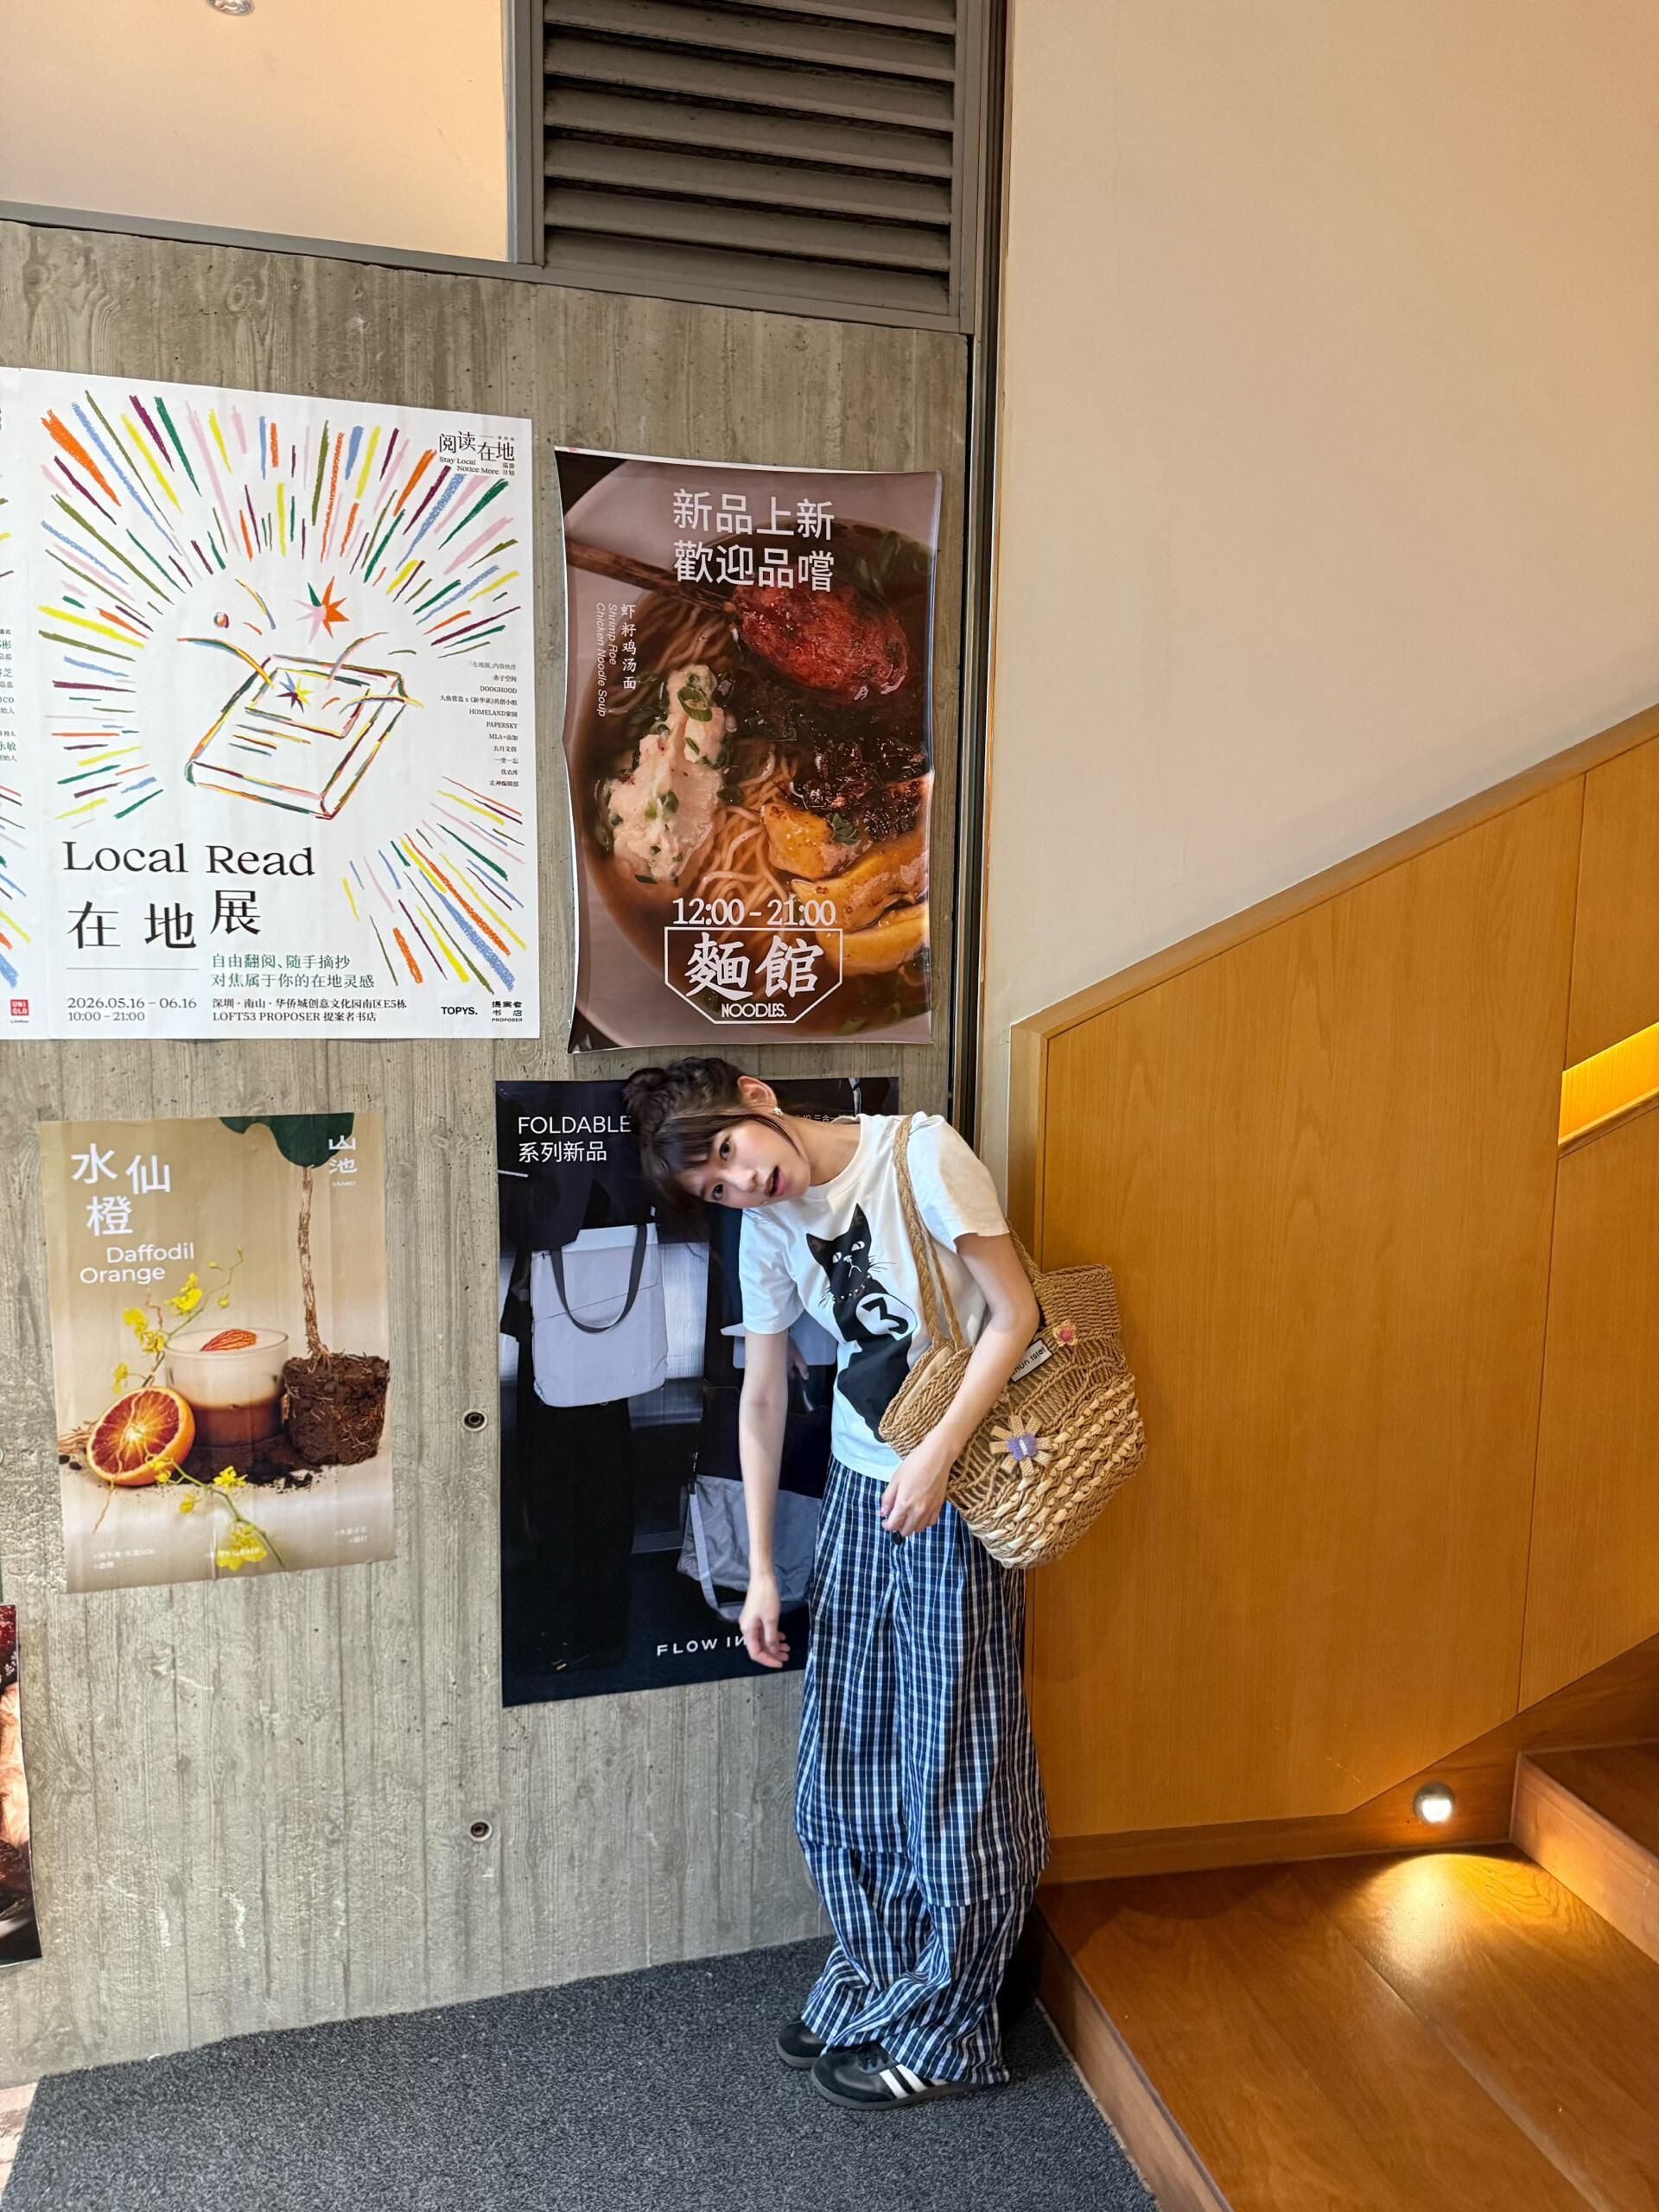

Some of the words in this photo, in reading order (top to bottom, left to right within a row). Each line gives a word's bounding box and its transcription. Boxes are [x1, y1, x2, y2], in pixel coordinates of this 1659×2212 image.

[439, 430, 515, 461] 阅读在地
[673, 488, 835, 541] 新品上新
[673, 539, 835, 593] 歡迎品嚐
[596, 602, 607, 646] Chicken
[607, 603, 618, 642] Shrimp
[608, 644, 619, 665] Roe
[621, 604, 637, 690] 虾籽鸡汤面
[597, 648, 607, 687] Noodle
[596, 689, 607, 717] Soup
[62, 841, 189, 873] Local
[205, 847, 315, 876] Read
[67, 890, 262, 949] 在地展
[673, 897, 745, 926] 12:00
[766, 897, 836, 926] 21:00
[213, 954, 351, 969] 自由翻阅、随手摘抄
[684, 931, 824, 1001] 麵館
[211, 973, 375, 988] 对焦属于你的在地灵感
[67, 997, 144, 1009] 2026.05.16
[159, 997, 197, 1009] 06.16
[68, 1012, 101, 1021] 10:00
[113, 1012, 145, 1021] 21:00
[213, 1012, 256, 1021] LOFT53
[259, 1012, 321, 1021] PROPOSER
[323, 1012, 377, 1022] 提案者书店
[441, 1007, 478, 1015] TOPYS.
[518, 1116, 632, 1134] FOLDABLE
[518, 1141, 607, 1163] 系列新品
[71, 1142, 171, 1195] 水仙
[86, 1195, 133, 1236] 橙
[106, 1243, 194, 1263] Daffodil
[79, 1267, 166, 1285] Orange
[657, 1638, 717, 1656] FLOW
